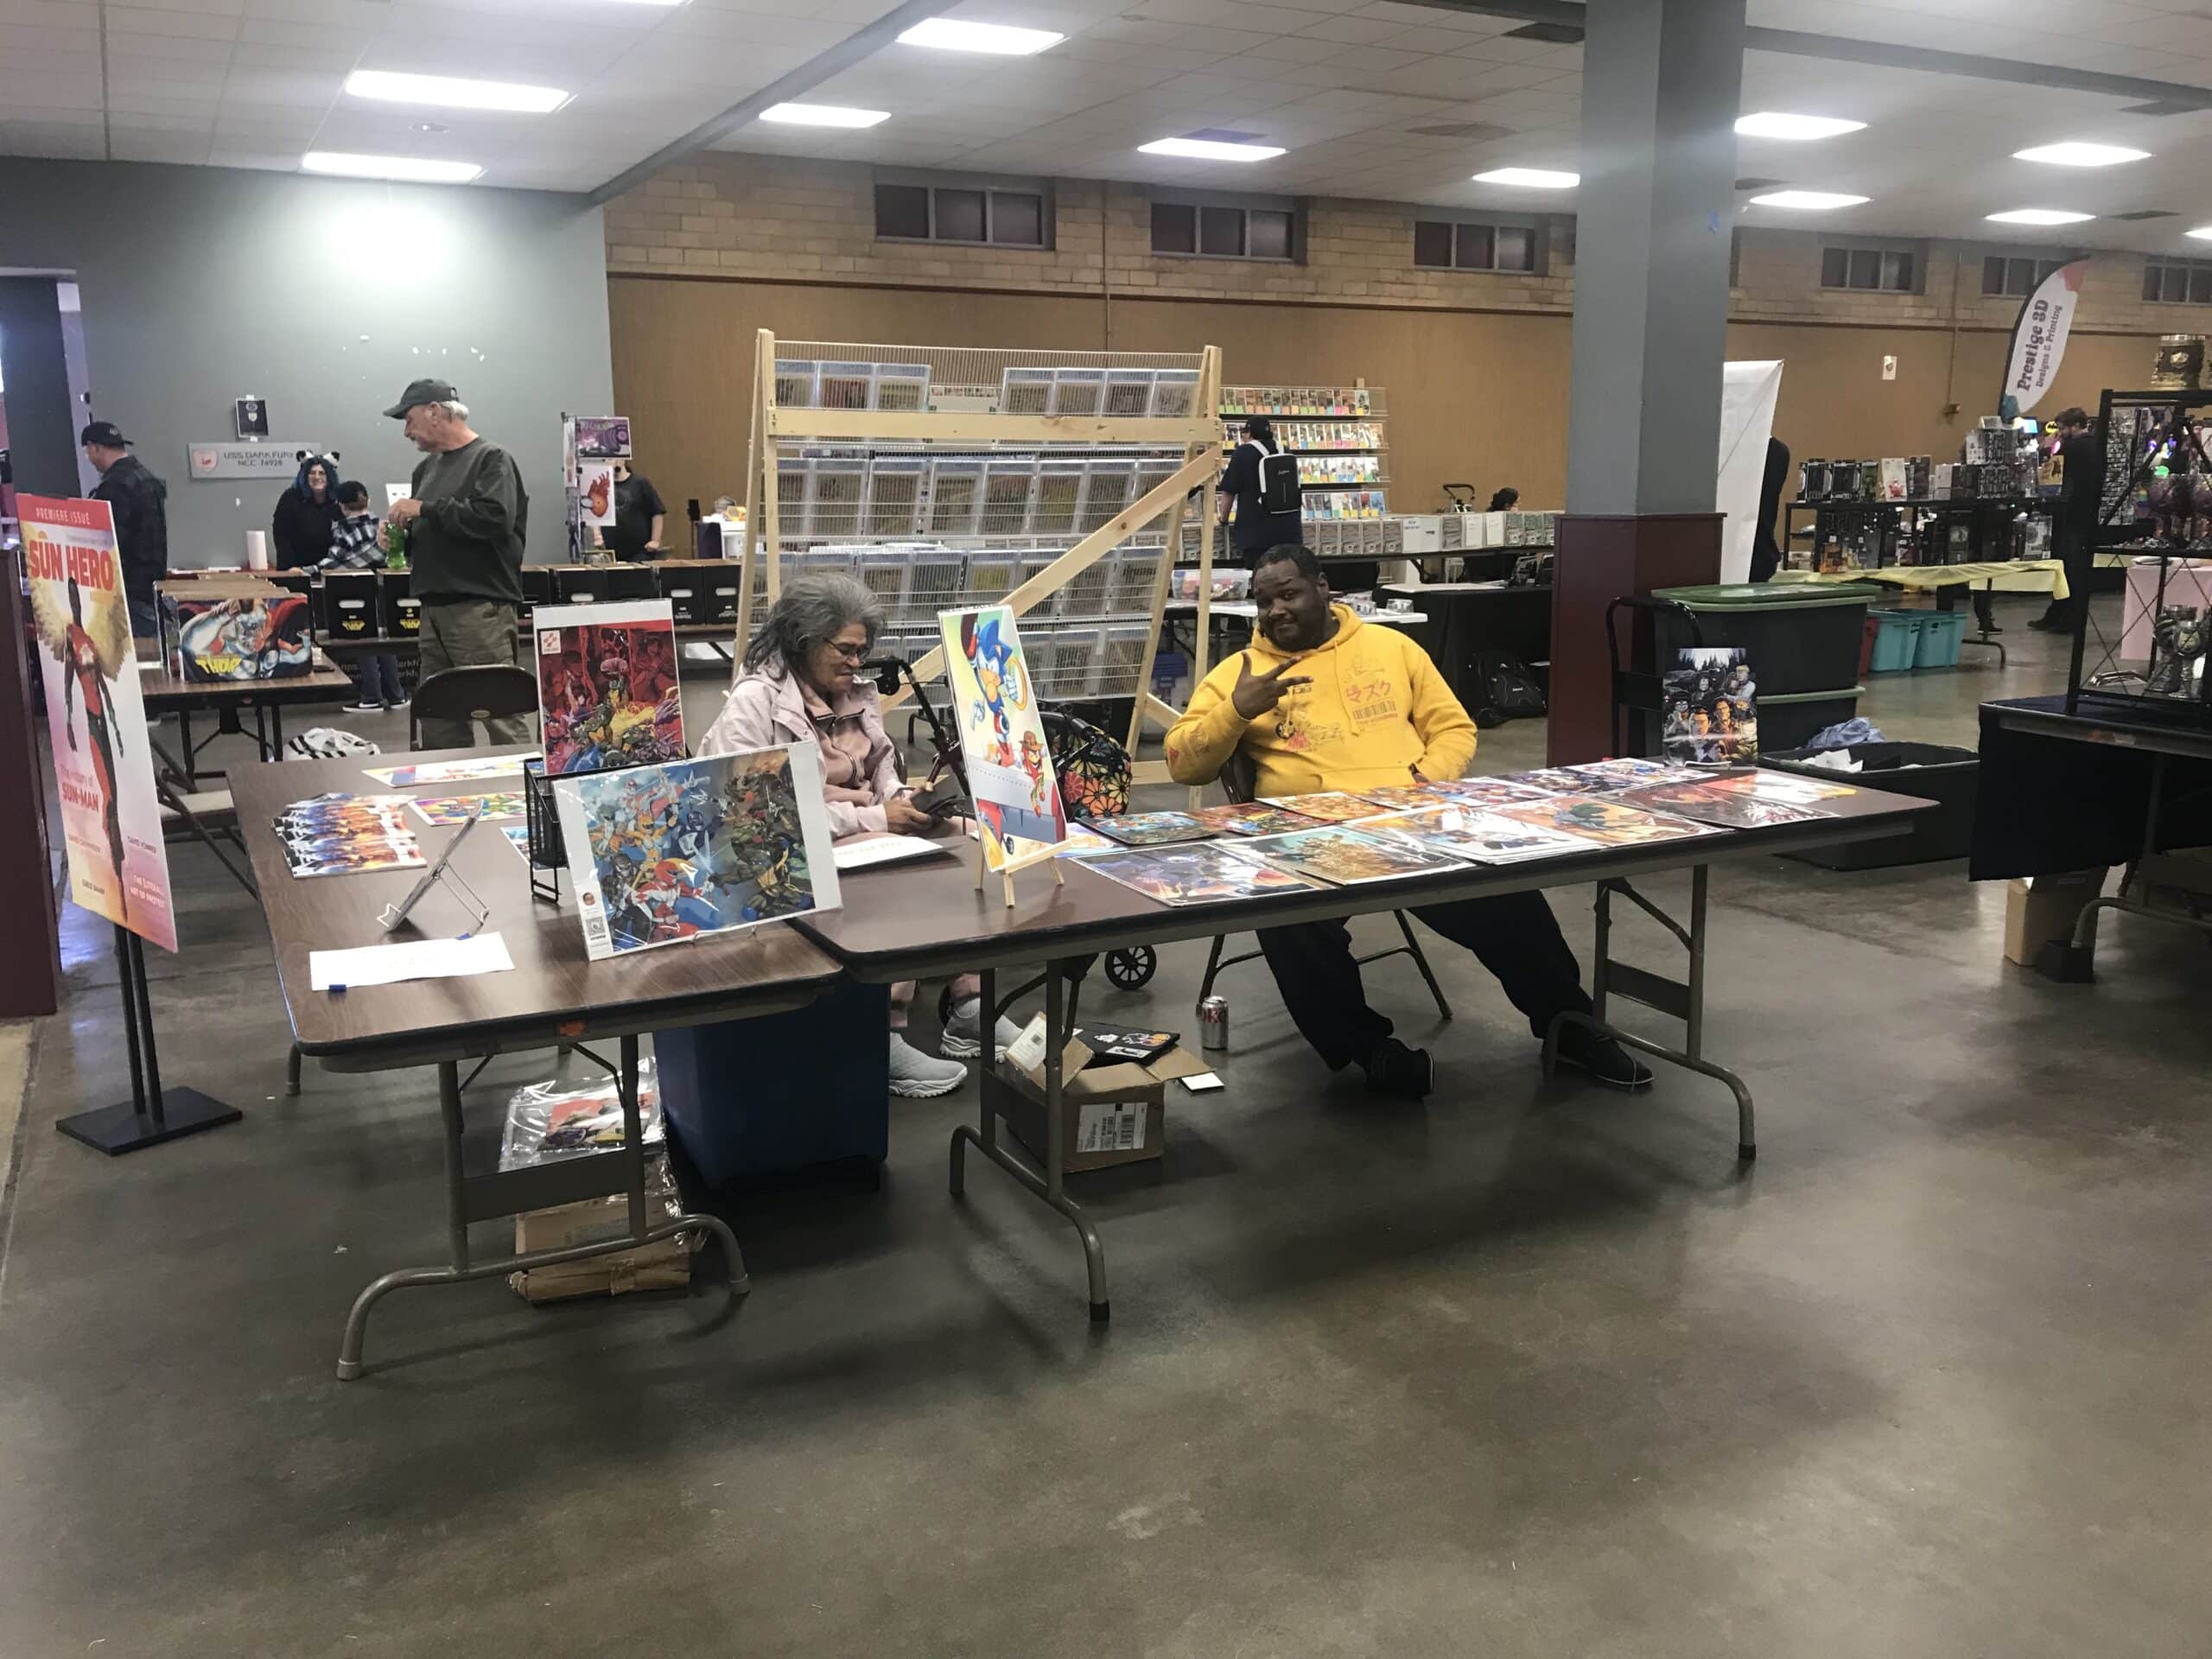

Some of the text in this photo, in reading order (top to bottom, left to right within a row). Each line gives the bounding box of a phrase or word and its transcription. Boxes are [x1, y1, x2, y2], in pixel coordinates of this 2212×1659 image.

[2018, 299, 2049, 391] Prestige 3D
[2036, 352, 2050, 388] Designs
[2046, 305, 2063, 343] Printing
[70, 511, 91, 525] ISSUE
[29, 538, 114, 591] SUN HERO
[194, 658, 242, 674] THOR
